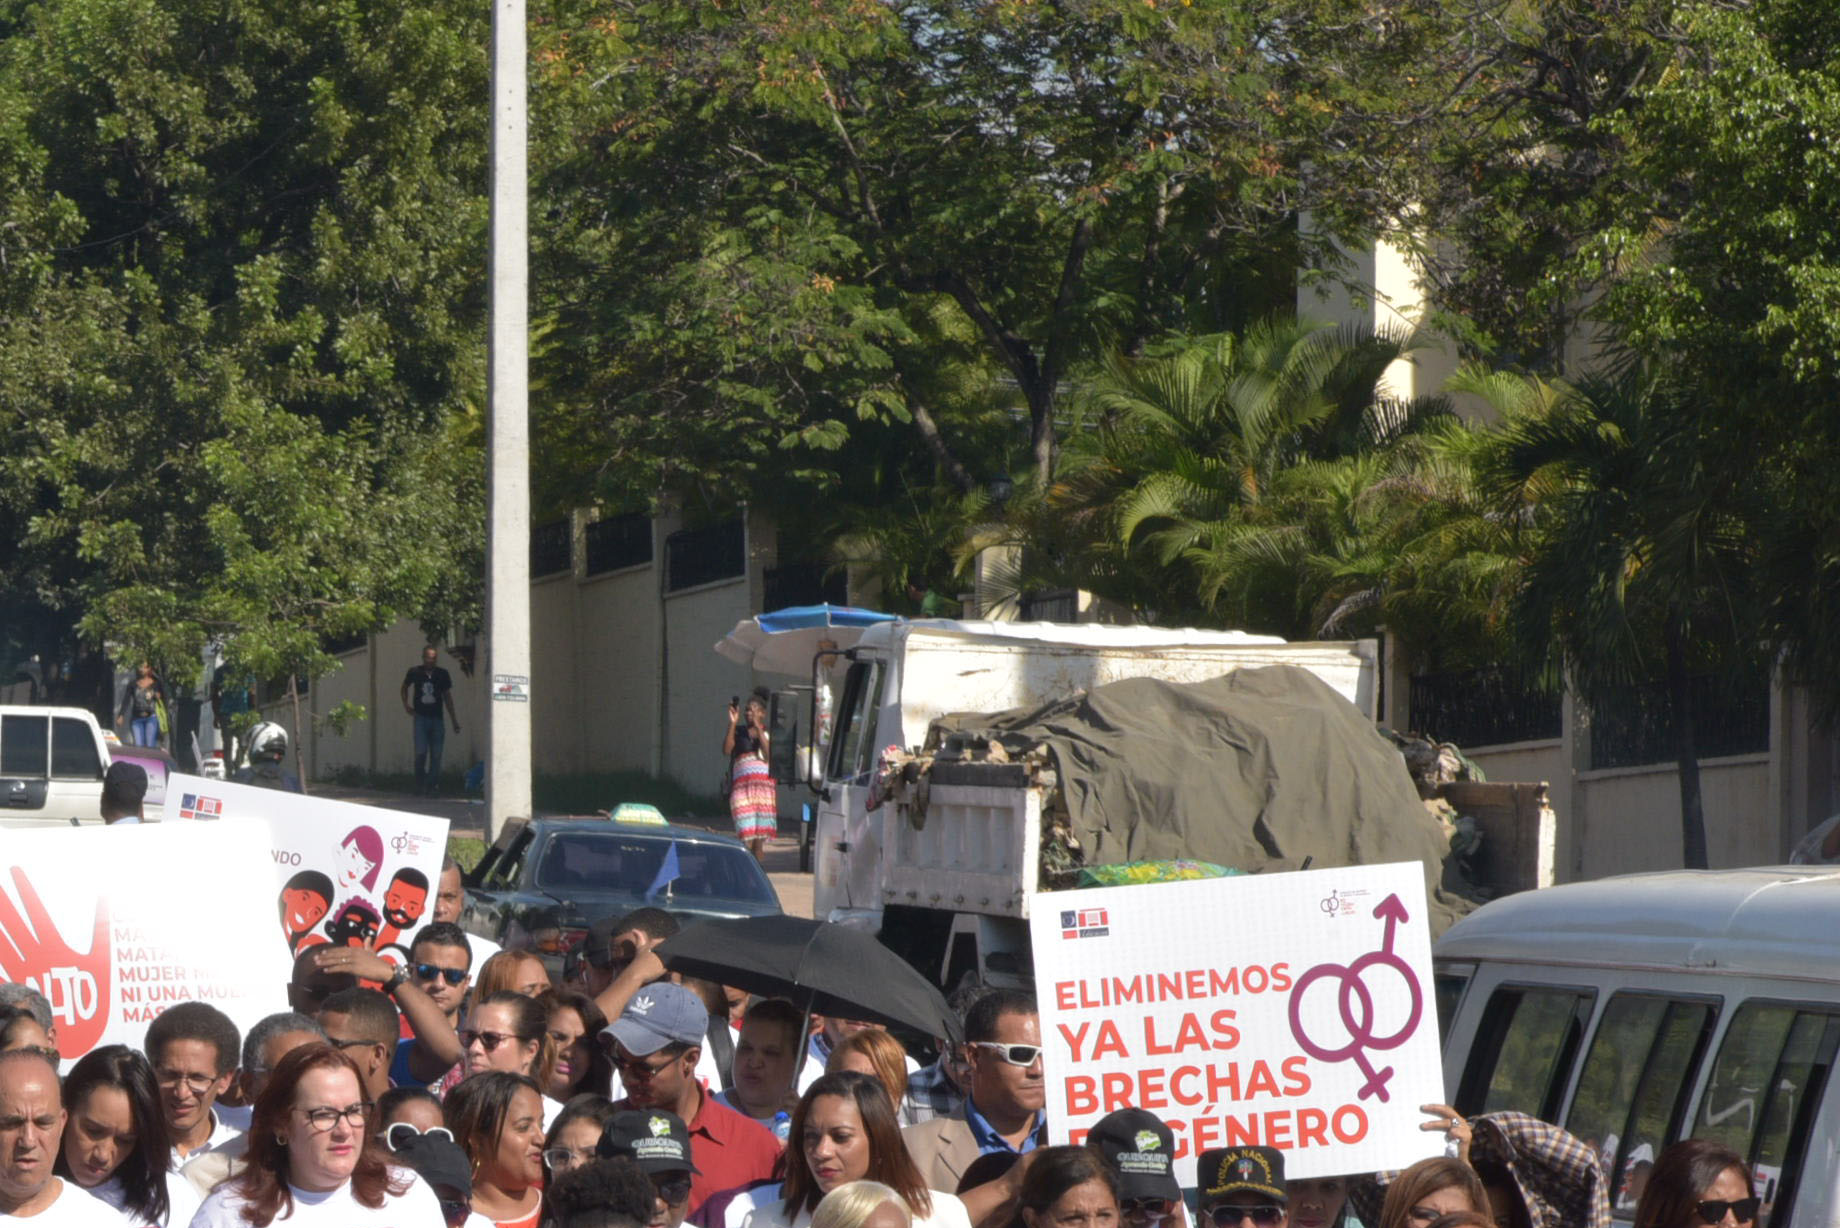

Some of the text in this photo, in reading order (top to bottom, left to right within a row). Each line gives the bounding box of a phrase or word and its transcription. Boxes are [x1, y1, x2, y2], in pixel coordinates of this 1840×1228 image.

[118, 965, 187, 983] MUJER
[121, 987, 142, 1004] NI
[148, 984, 192, 1002] UNA
[1055, 962, 1293, 1011] ELIMINEMOS
[1056, 1009, 1241, 1063] YA LAS
[1064, 1055, 1312, 1117] BRECHAS
